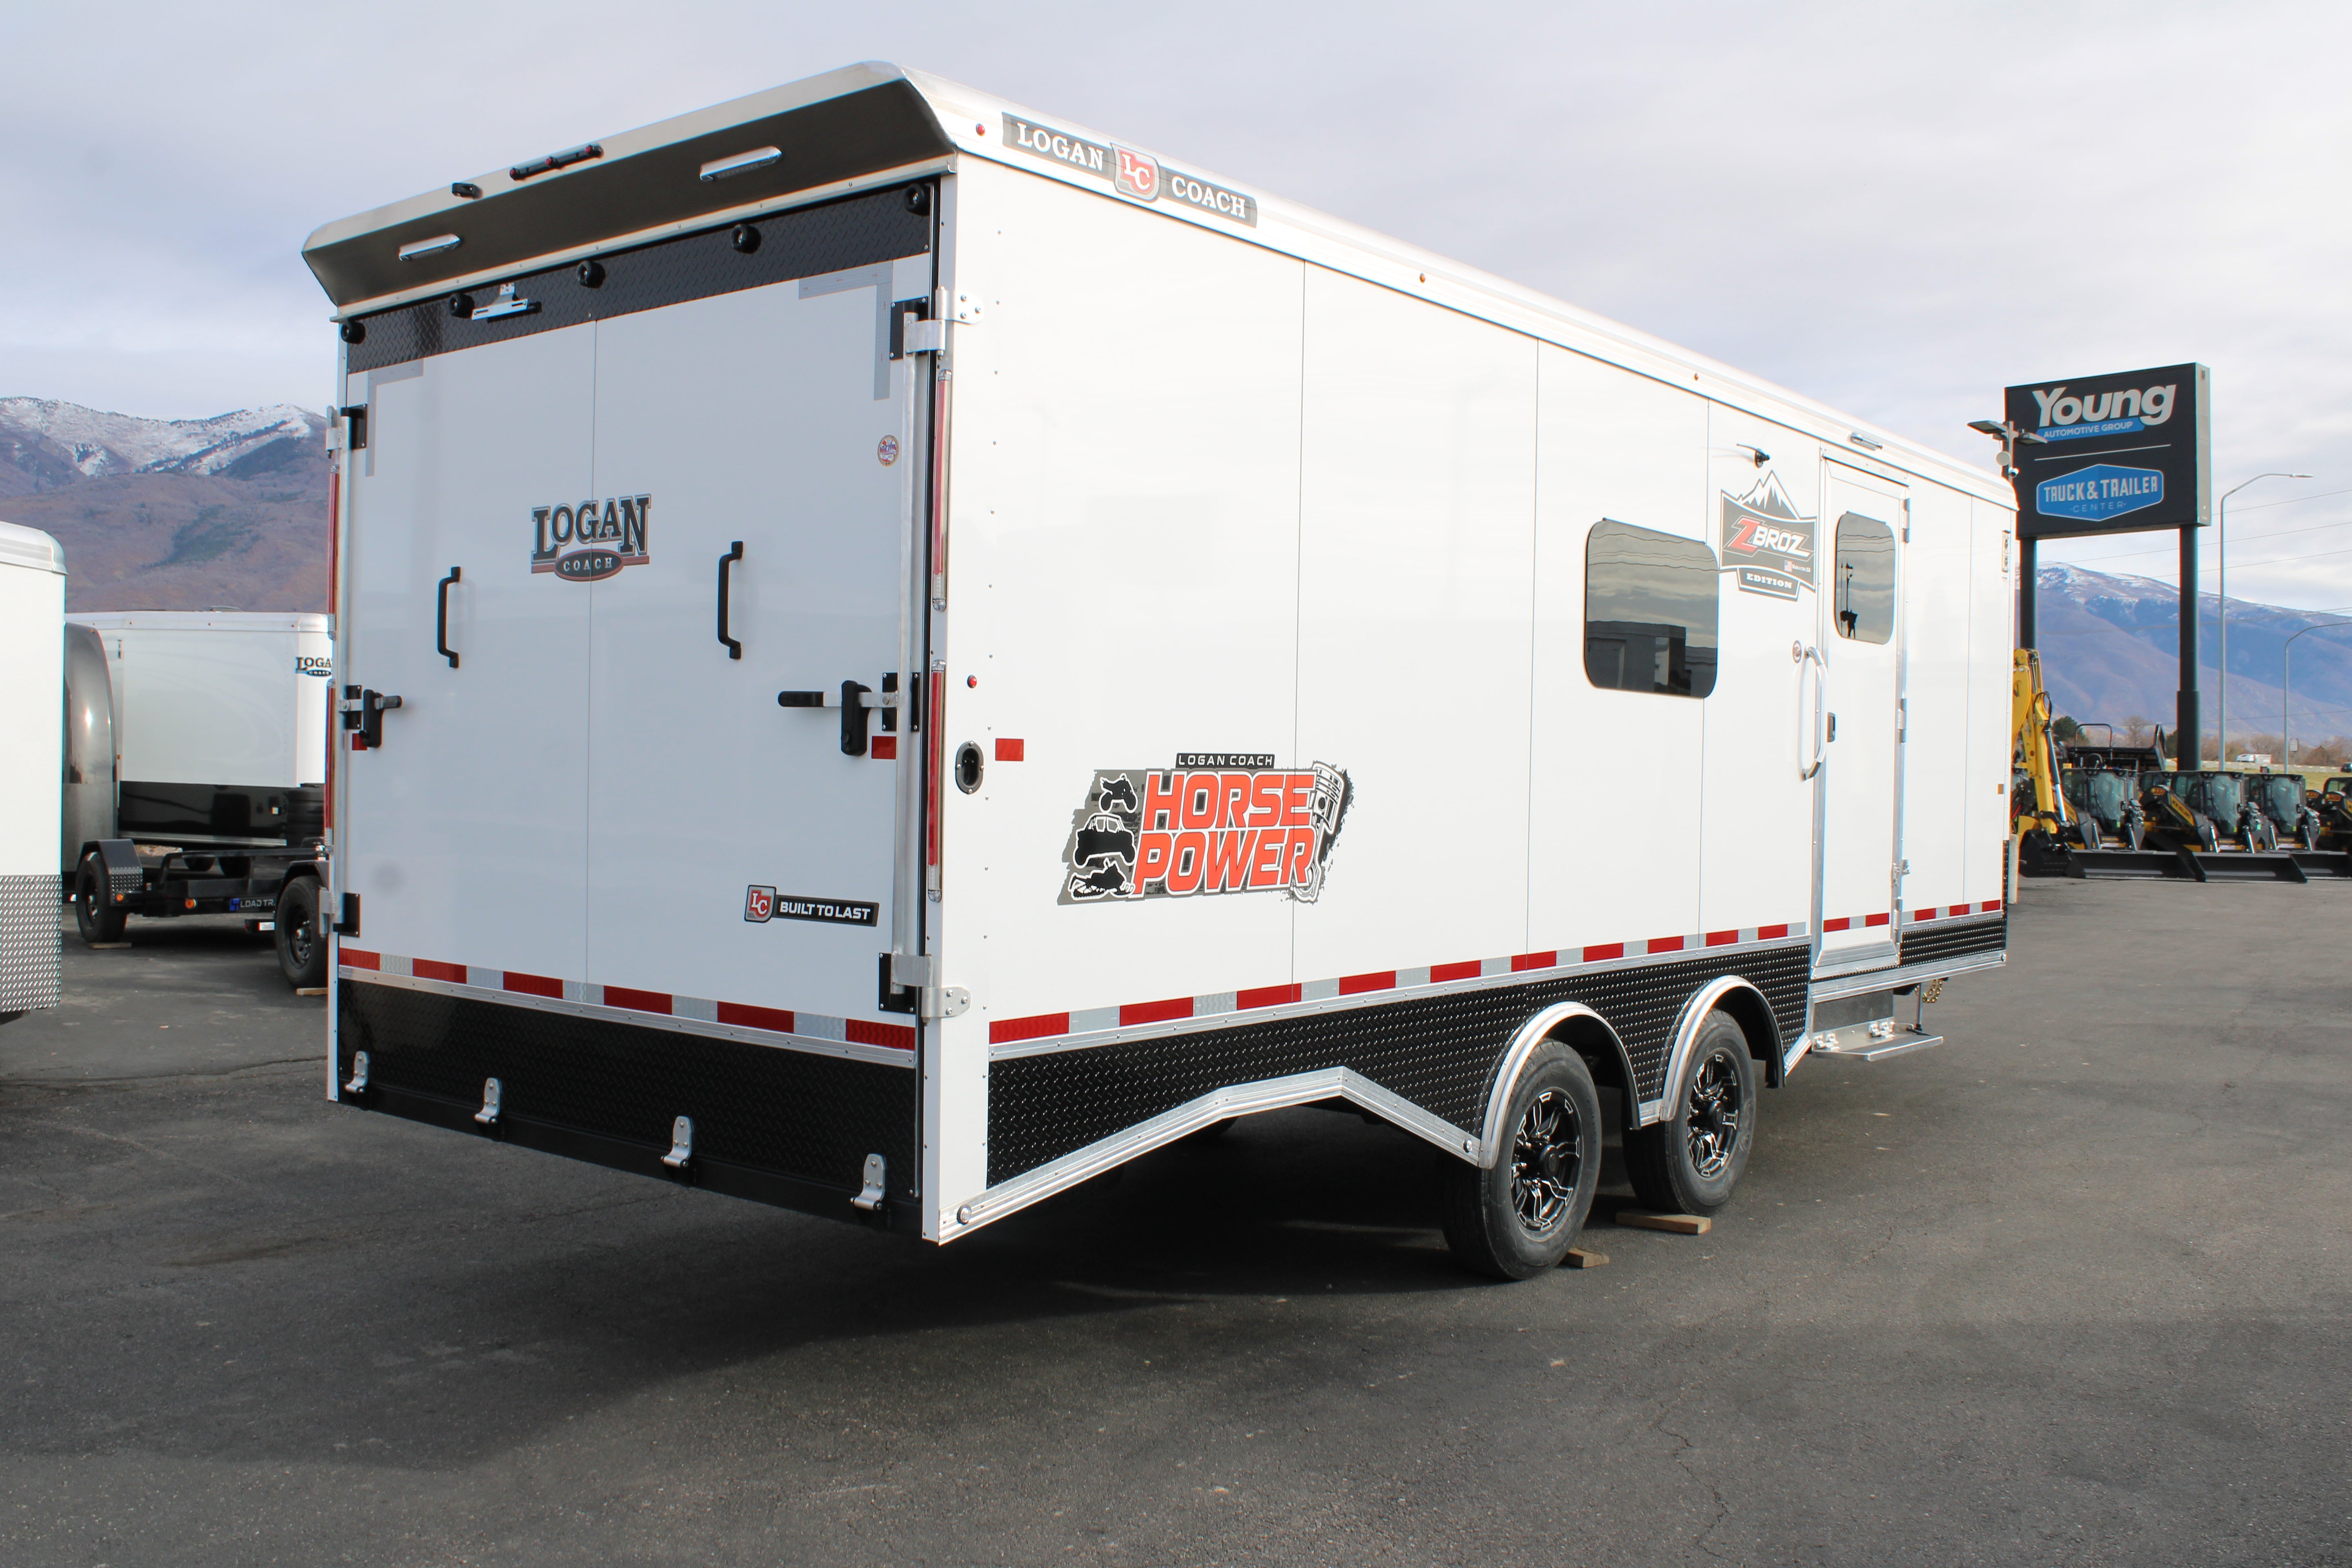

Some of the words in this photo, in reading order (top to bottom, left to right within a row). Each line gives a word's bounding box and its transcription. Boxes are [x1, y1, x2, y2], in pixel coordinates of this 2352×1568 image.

[1017, 122, 1103, 171] LOGAN
[1172, 175, 1246, 218] COACH
[2032, 384, 2177, 428] Young
[2043, 425, 2100, 439] AUTOMOTIVE
[2102, 421, 2134, 432] GROUP
[2044, 482, 2084, 503] TRUCK
[2087, 481, 2098, 500] &
[2100, 476, 2158, 499] TRAILER
[531, 493, 652, 565] LOGAN
[1728, 518, 1812, 557] ZBROZ
[564, 557, 612, 572] COACH
[1746, 572, 1793, 589] EDITION
[296, 657, 332, 670] LOGA
[1178, 754, 1225, 766] LOGAN
[1229, 755, 1273, 767] COACH
[1143, 772, 1317, 831] HORSE
[1133, 828, 1316, 895] POWER
[240, 900, 262, 908] LOAD
[751, 893, 768, 915] LC
[780, 901, 815, 915] BUILT
[817, 904, 835, 917] TO
[835, 906, 871, 920] LAST
